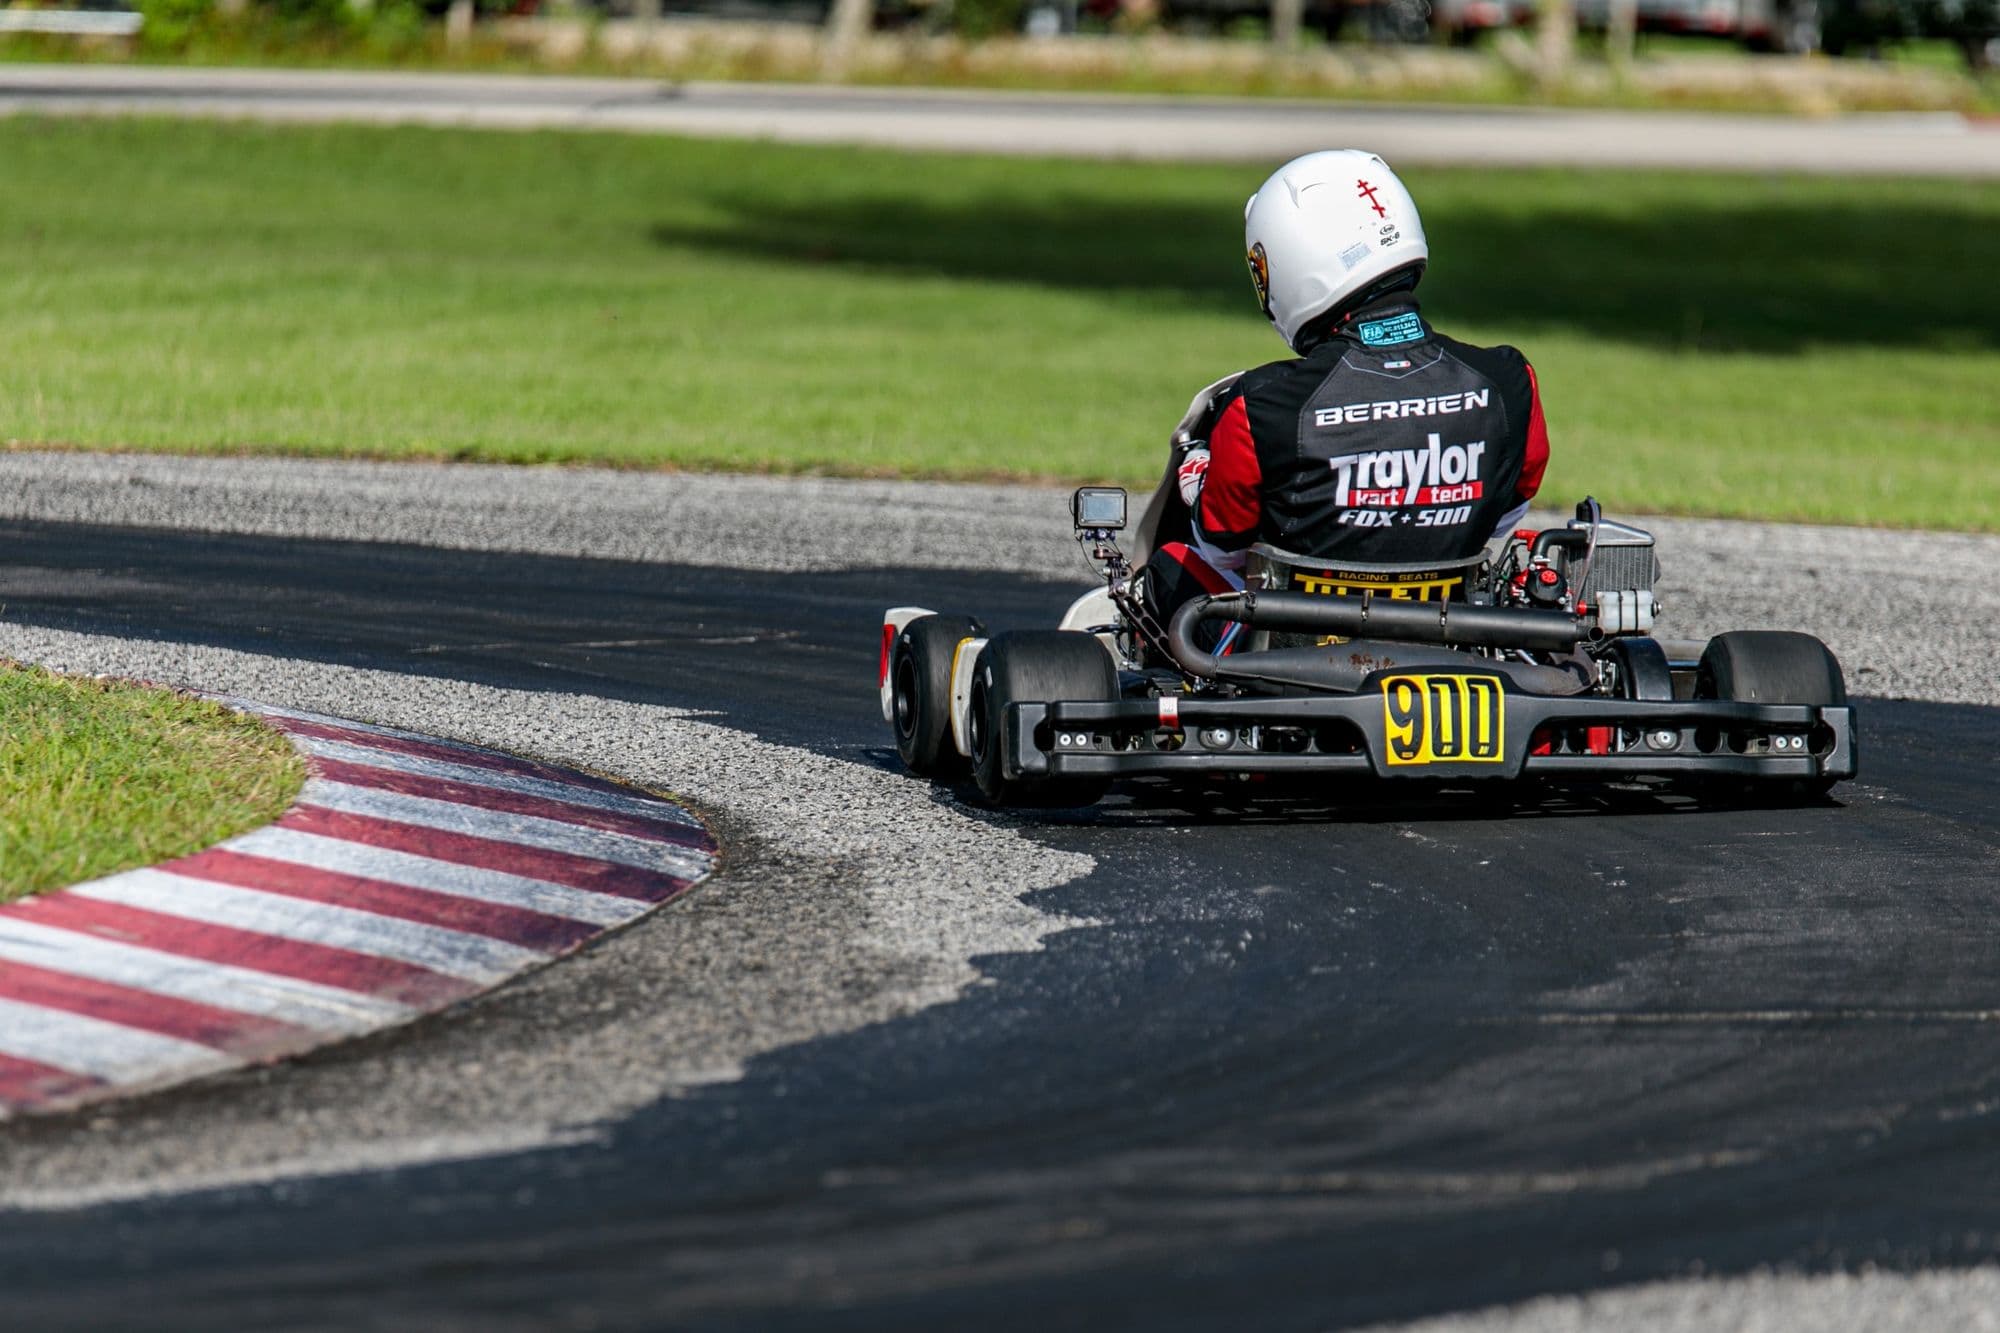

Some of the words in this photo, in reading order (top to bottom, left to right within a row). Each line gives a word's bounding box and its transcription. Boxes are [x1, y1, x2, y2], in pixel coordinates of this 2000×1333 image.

[1315, 388, 1489, 427] BERRIEN
[1330, 433, 1486, 507] Traylor
[1355, 489, 1401, 506] kart
[1430, 484, 1474, 505] tech
[1338, 509, 1398, 528] FOX
[1338, 571, 1389, 582] RACING
[1398, 572, 1439, 582] SEATS
